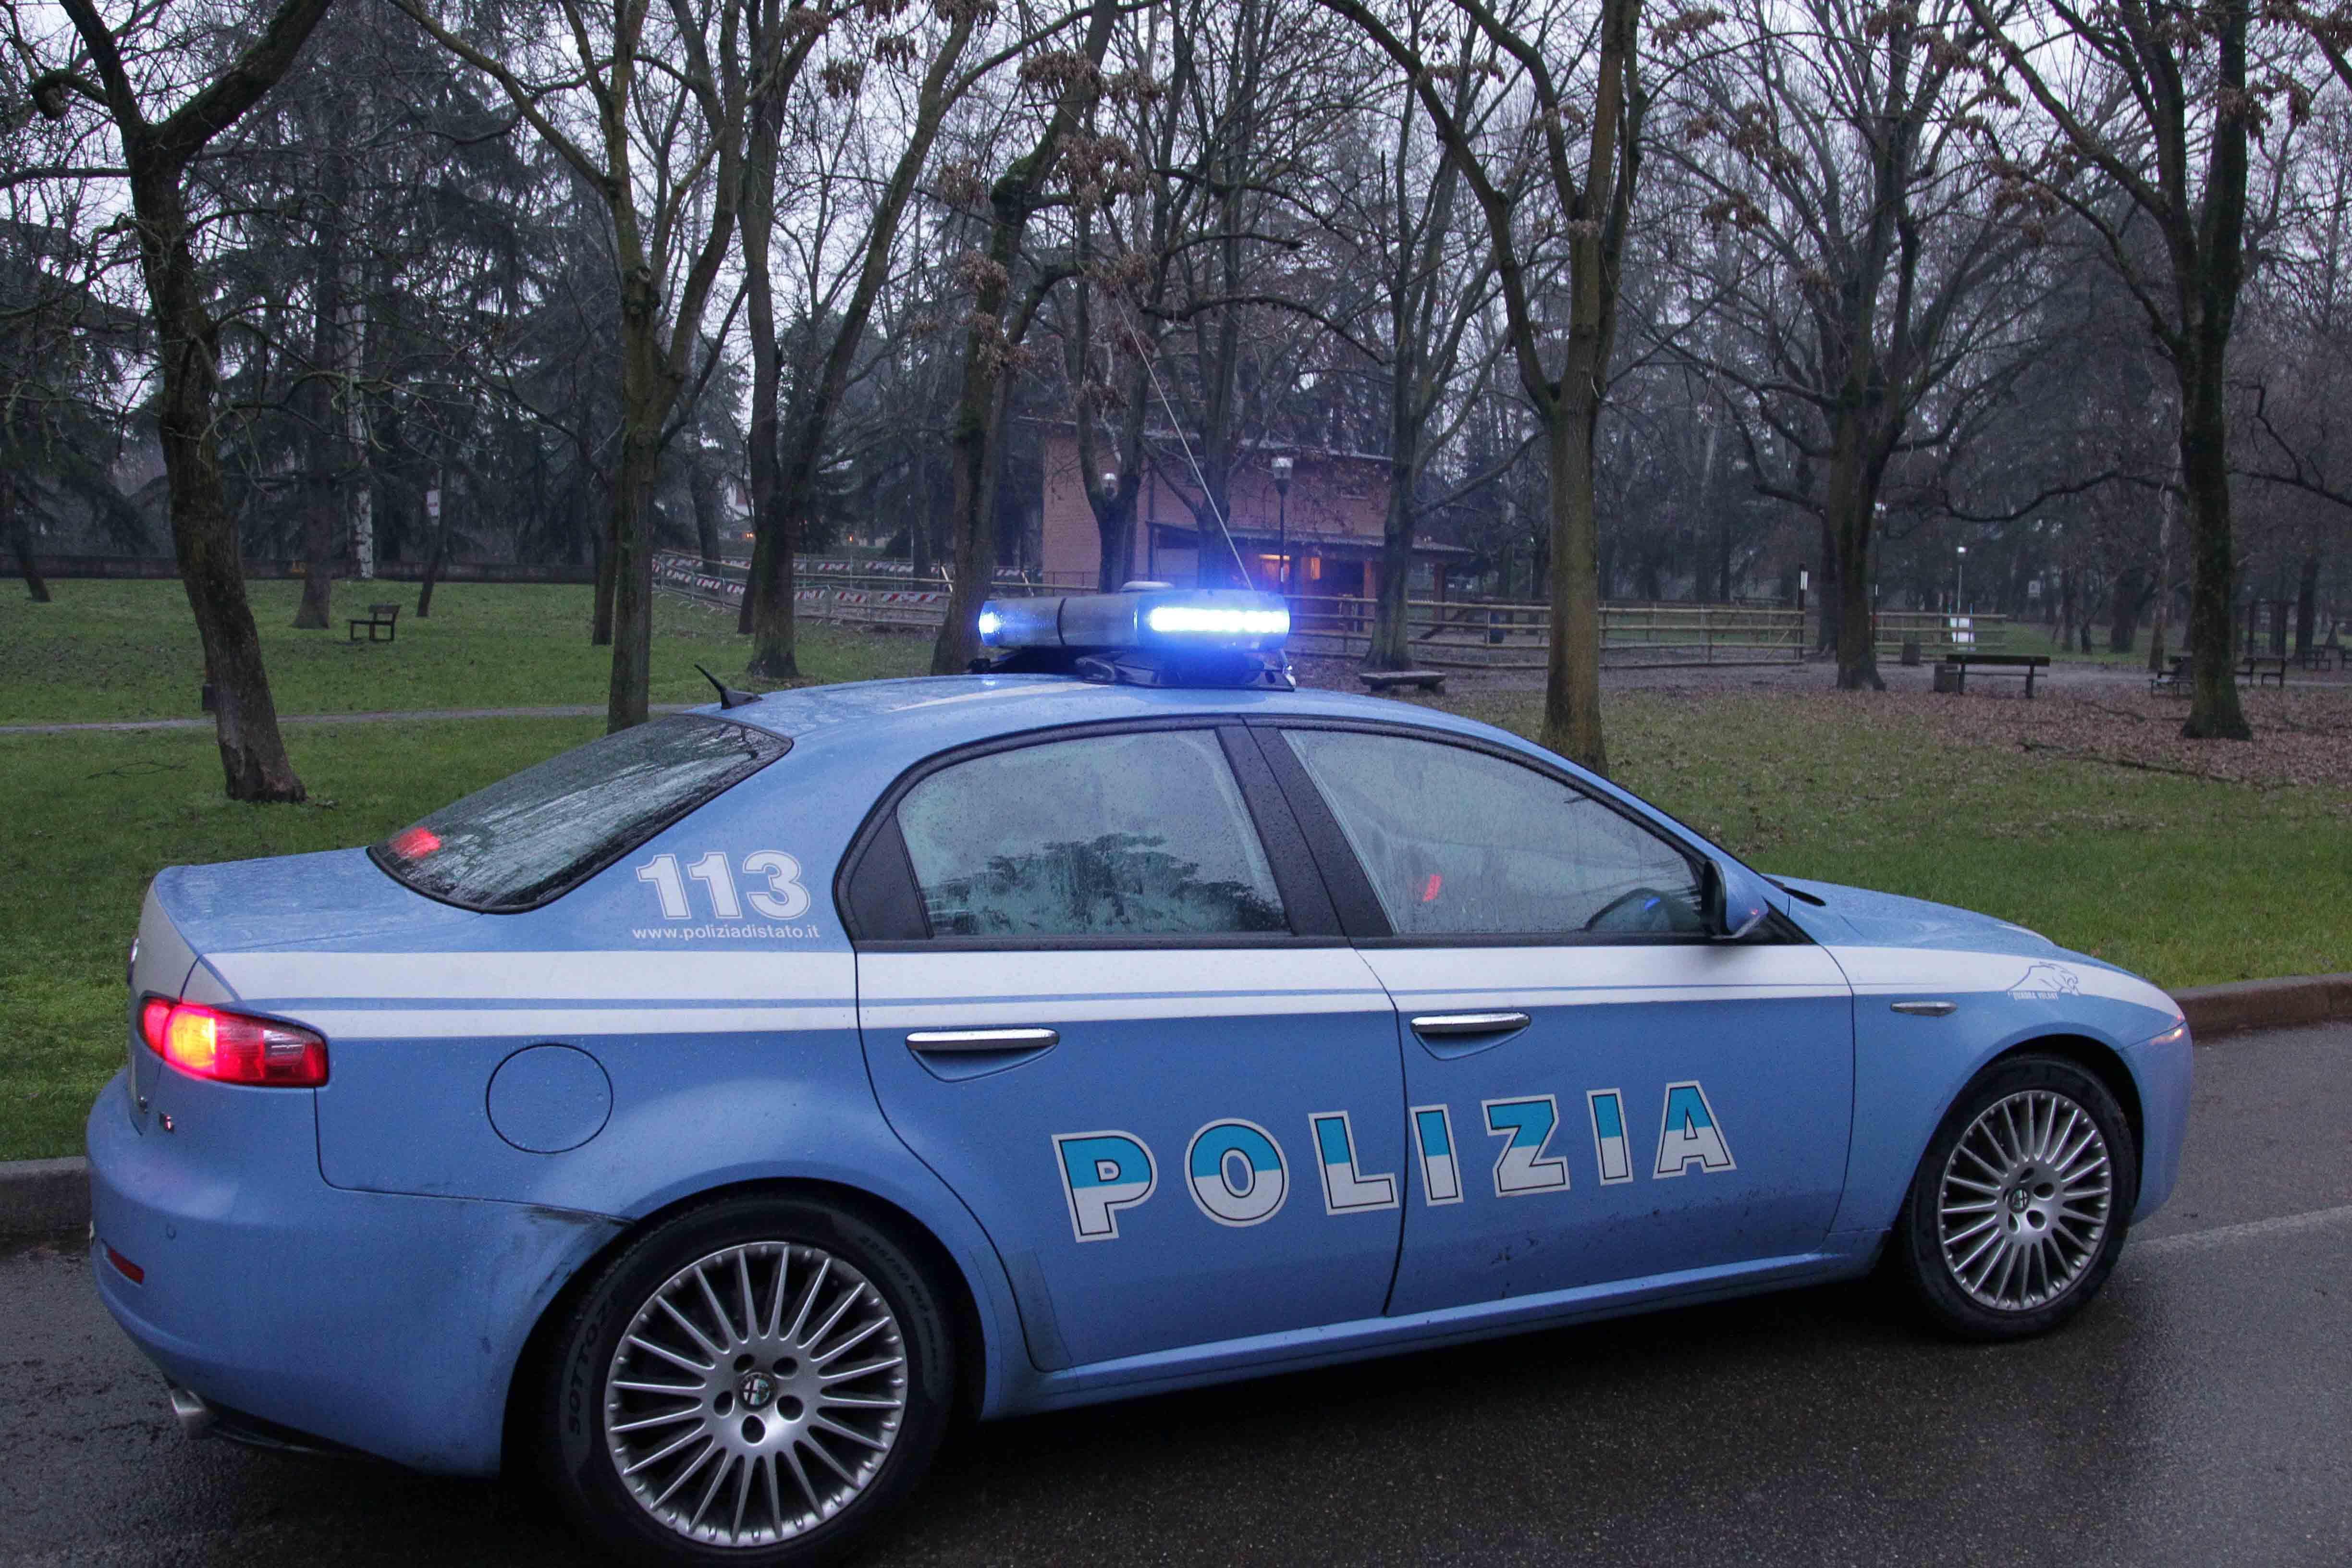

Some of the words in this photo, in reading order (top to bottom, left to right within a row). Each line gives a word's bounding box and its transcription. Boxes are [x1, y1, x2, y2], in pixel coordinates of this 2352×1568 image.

[635, 849, 810, 920] 113
[632, 925, 820, 941] www.poliziadistato.it
[1051, 1079, 1737, 1243] POLIZIA
